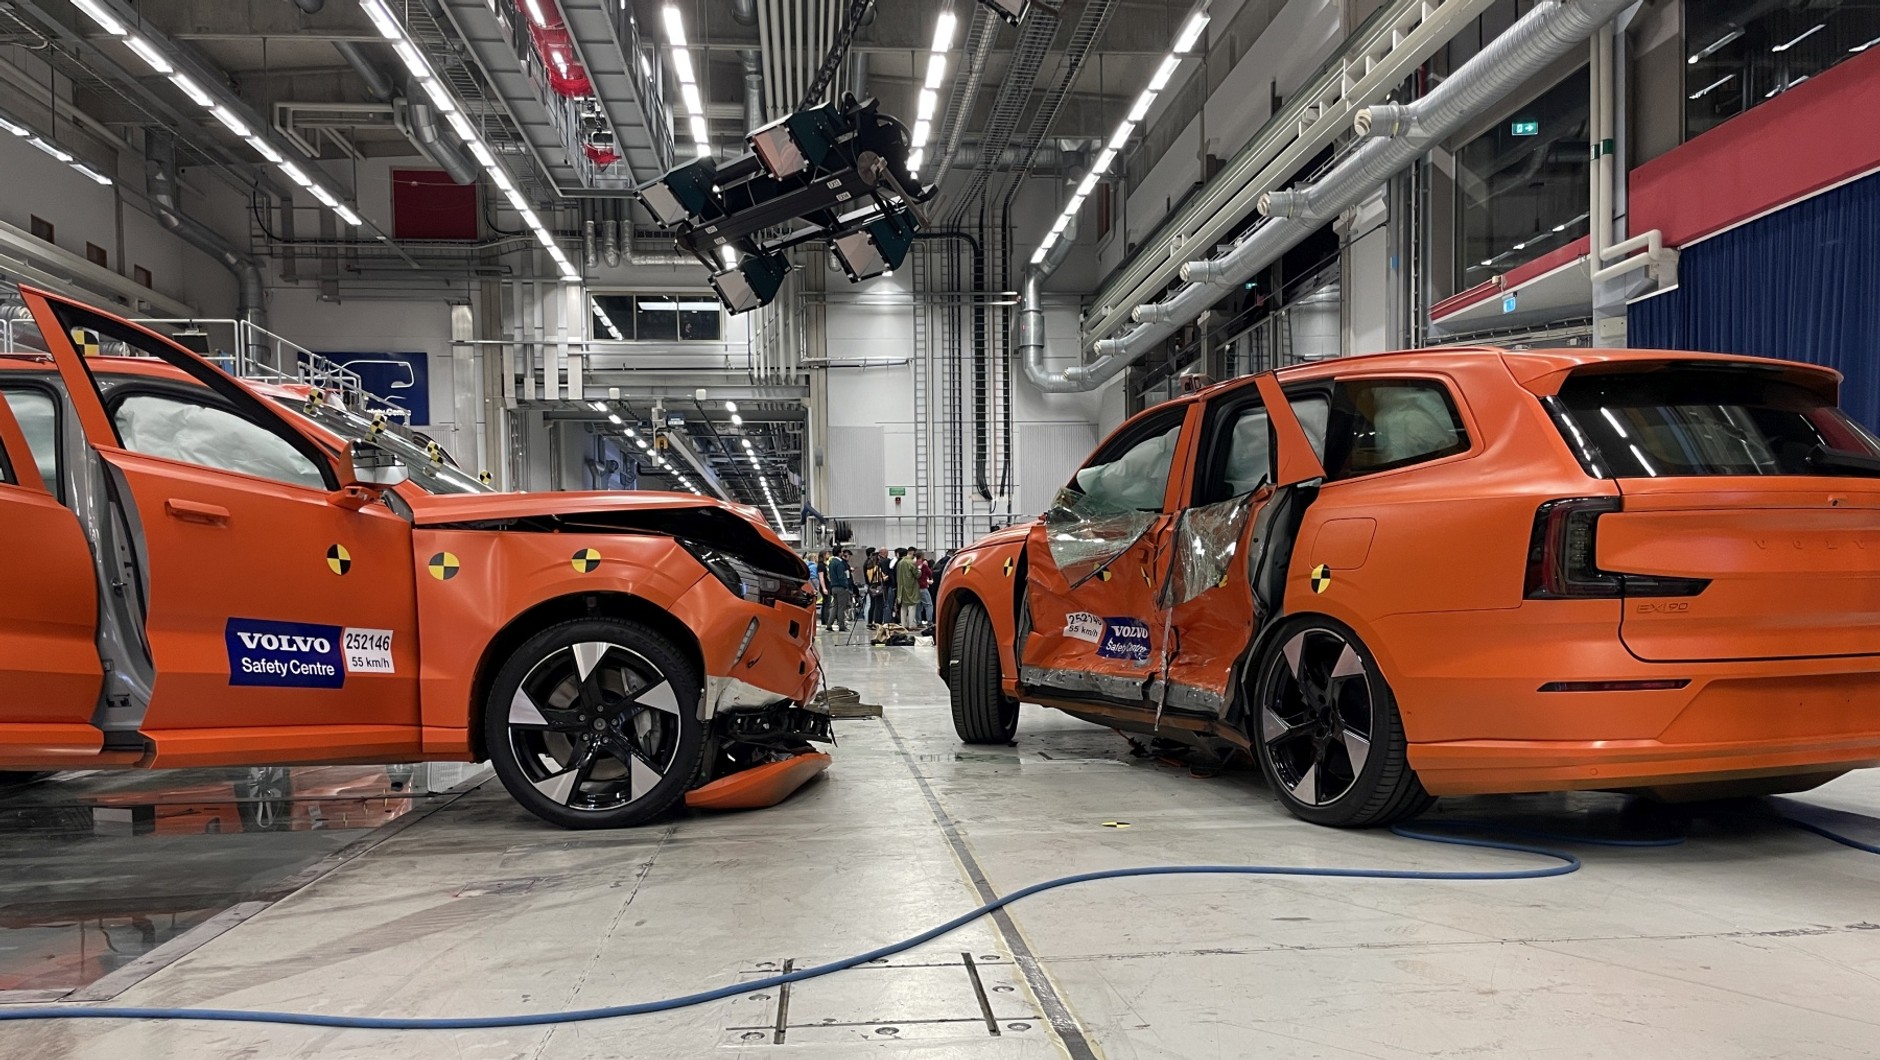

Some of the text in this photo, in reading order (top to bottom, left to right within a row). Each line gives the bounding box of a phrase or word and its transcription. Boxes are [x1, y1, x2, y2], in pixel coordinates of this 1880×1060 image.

[1068, 624, 1079, 633] 55
[1111, 626, 1148, 639] VOLVO
[237, 631, 331, 654] VOLVO
[345, 632, 390, 652] 252146
[241, 657, 336, 677] Safety Centre
[352, 656, 390, 668] 55 km/h
